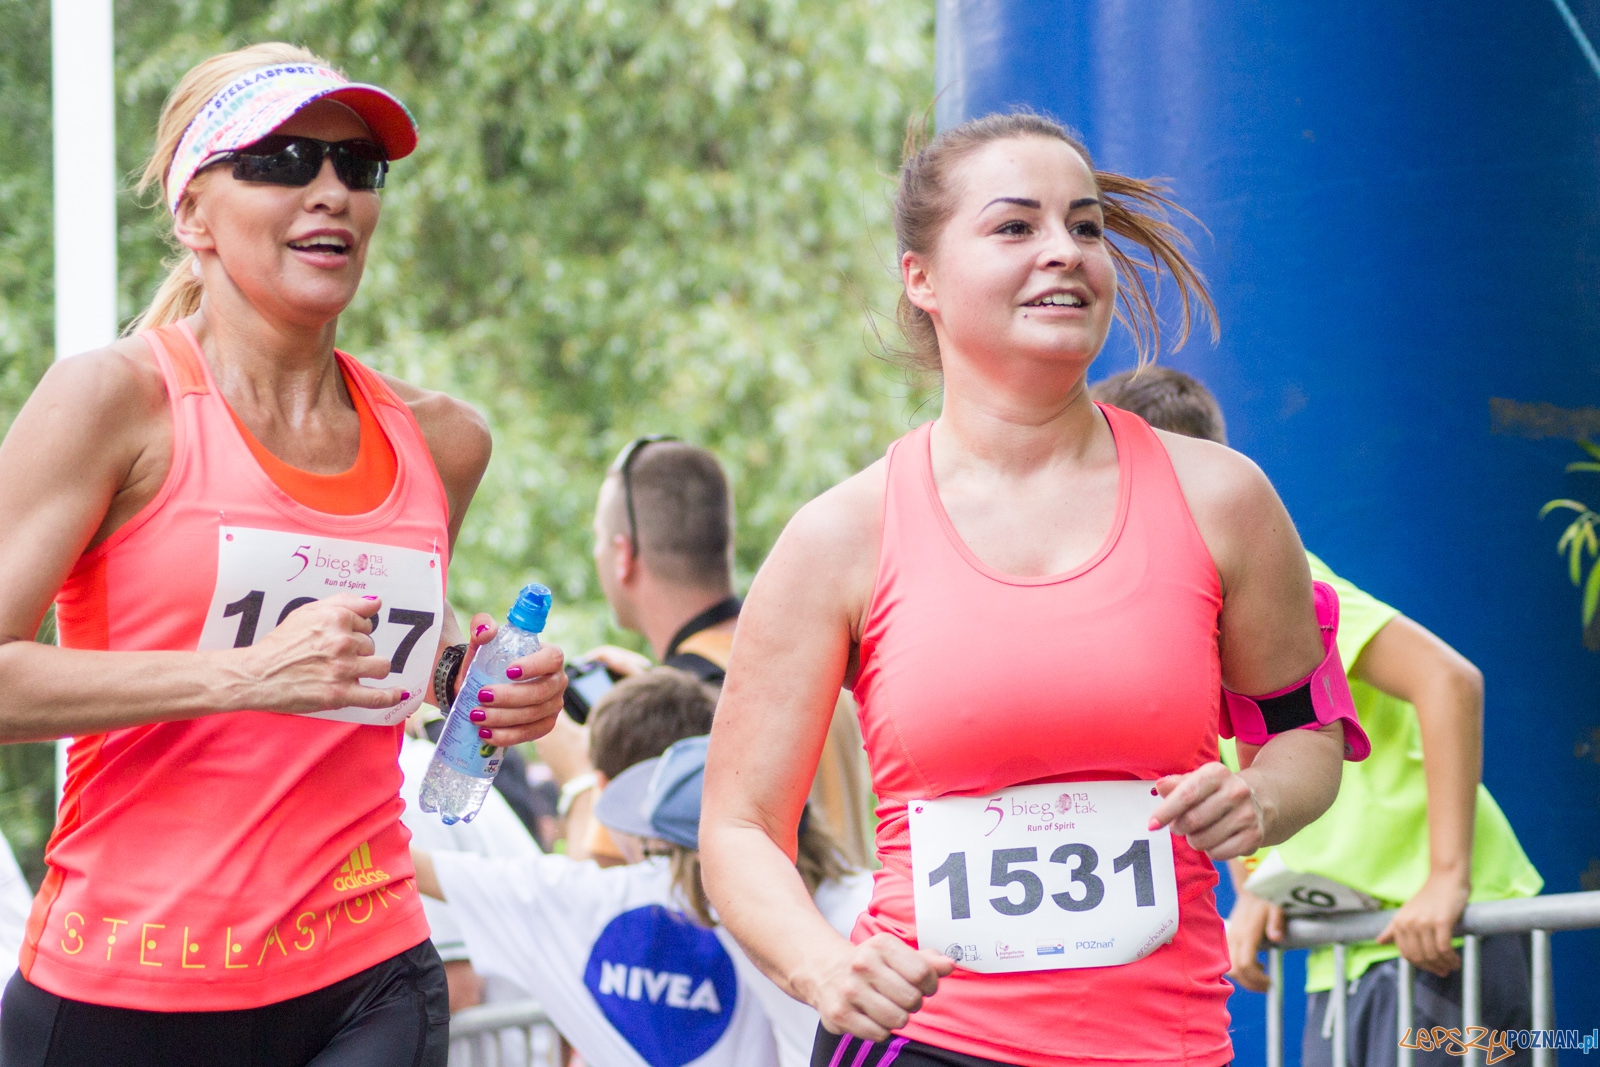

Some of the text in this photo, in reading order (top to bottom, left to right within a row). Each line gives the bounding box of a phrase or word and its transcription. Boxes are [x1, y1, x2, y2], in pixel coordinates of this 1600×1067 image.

[214, 66, 316, 110] STELLASPORT
[286, 545, 351, 582] 5 bieg
[370, 554, 383, 564] na
[369, 563, 389, 577] tak
[324, 578, 338, 586] Run
[347, 581, 367, 590] Spirit
[1072, 792, 1089, 802] na
[1074, 801, 1098, 814] tak
[984, 796, 1055, 837] 5 bieg
[1027, 821, 1075, 832] Run of Spirit
[333, 868, 391, 892] adidas
[928, 839, 1156, 920] 1531
[964, 944, 977, 952] na
[964, 951, 983, 962] tak
[599, 960, 721, 1014] NIVEA
